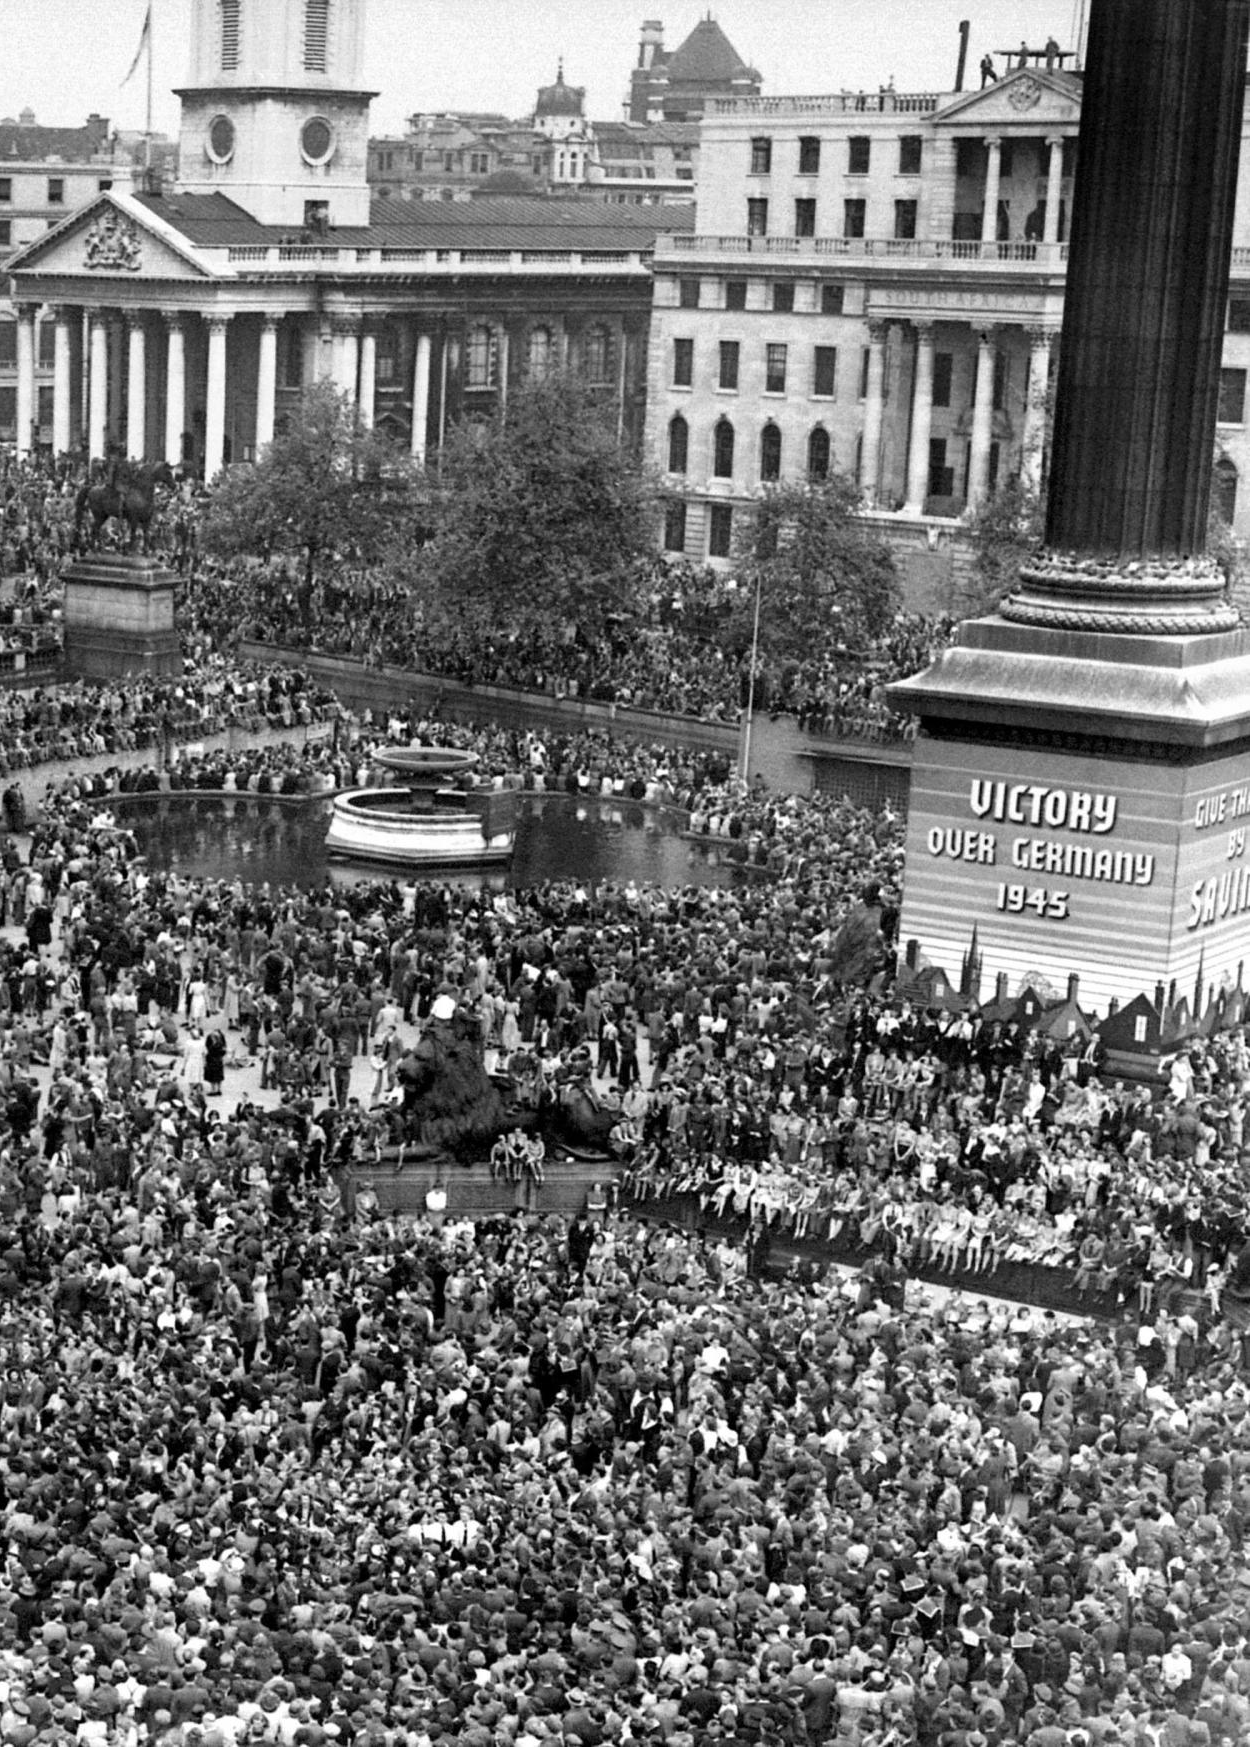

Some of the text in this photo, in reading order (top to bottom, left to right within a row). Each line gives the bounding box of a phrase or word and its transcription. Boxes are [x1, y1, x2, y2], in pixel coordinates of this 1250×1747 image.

[885, 290, 949, 305] SOUTH
[969, 779, 1117, 833] VICTORY
[1195, 786, 1250, 829] GIVE TH
[927, 826, 1154, 885] OVER GERMANY
[1228, 827, 1245, 859] BY
[997, 883, 1069, 918] 1945
